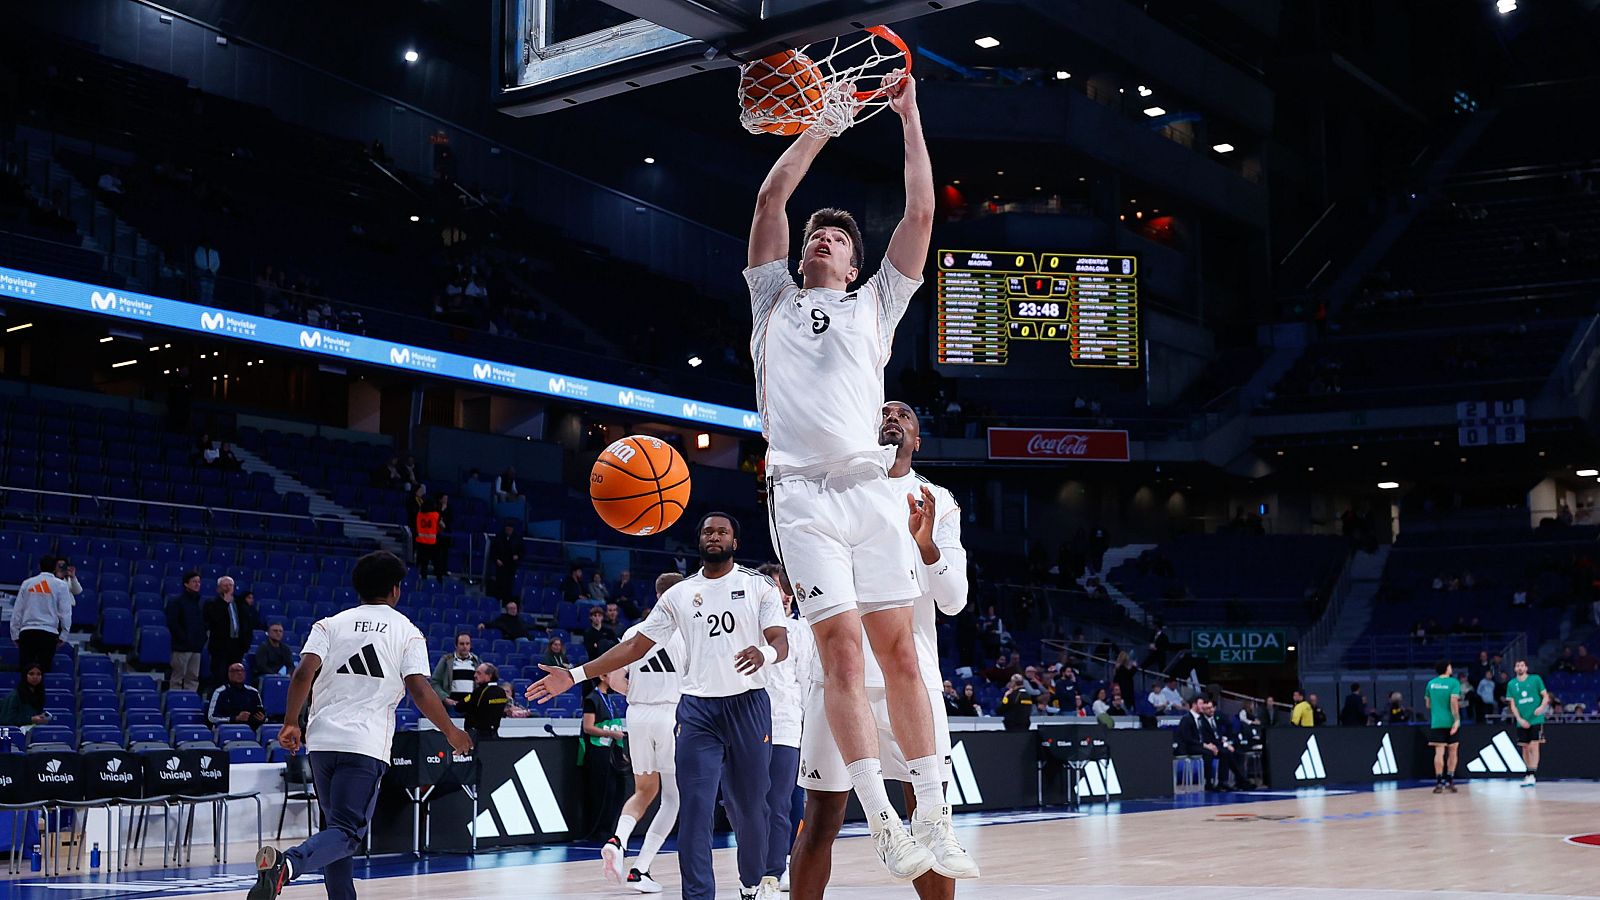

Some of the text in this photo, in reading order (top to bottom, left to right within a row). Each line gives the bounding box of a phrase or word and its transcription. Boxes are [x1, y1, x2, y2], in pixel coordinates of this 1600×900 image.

[971, 252, 988, 260] REAL
[1015, 255, 1024, 267] 0
[1050, 257, 1059, 268] 0
[0, 275, 37, 289] Movistar
[1036, 280, 1043, 290] 1
[119, 297, 153, 309] Movistar
[1018, 302, 1059, 317] 23:48
[226, 317, 257, 330] Movistar
[810, 308, 830, 334] 9
[1021, 326, 1030, 337] 0
[1047, 327, 1056, 338] 0
[323, 335, 351, 347] Movistar
[411, 351, 437, 362] Movistar
[354, 621, 388, 633] FELIZ
[707, 611, 735, 637] 20
[1197, 632, 1279, 648] SALIDA
[1220, 649, 1257, 661] EXIT
[426, 755, 441, 763] acb
[38, 773, 74, 784] Unicaja
[100, 771, 133, 782] Unicaja
[159, 769, 192, 781] Unicaja
